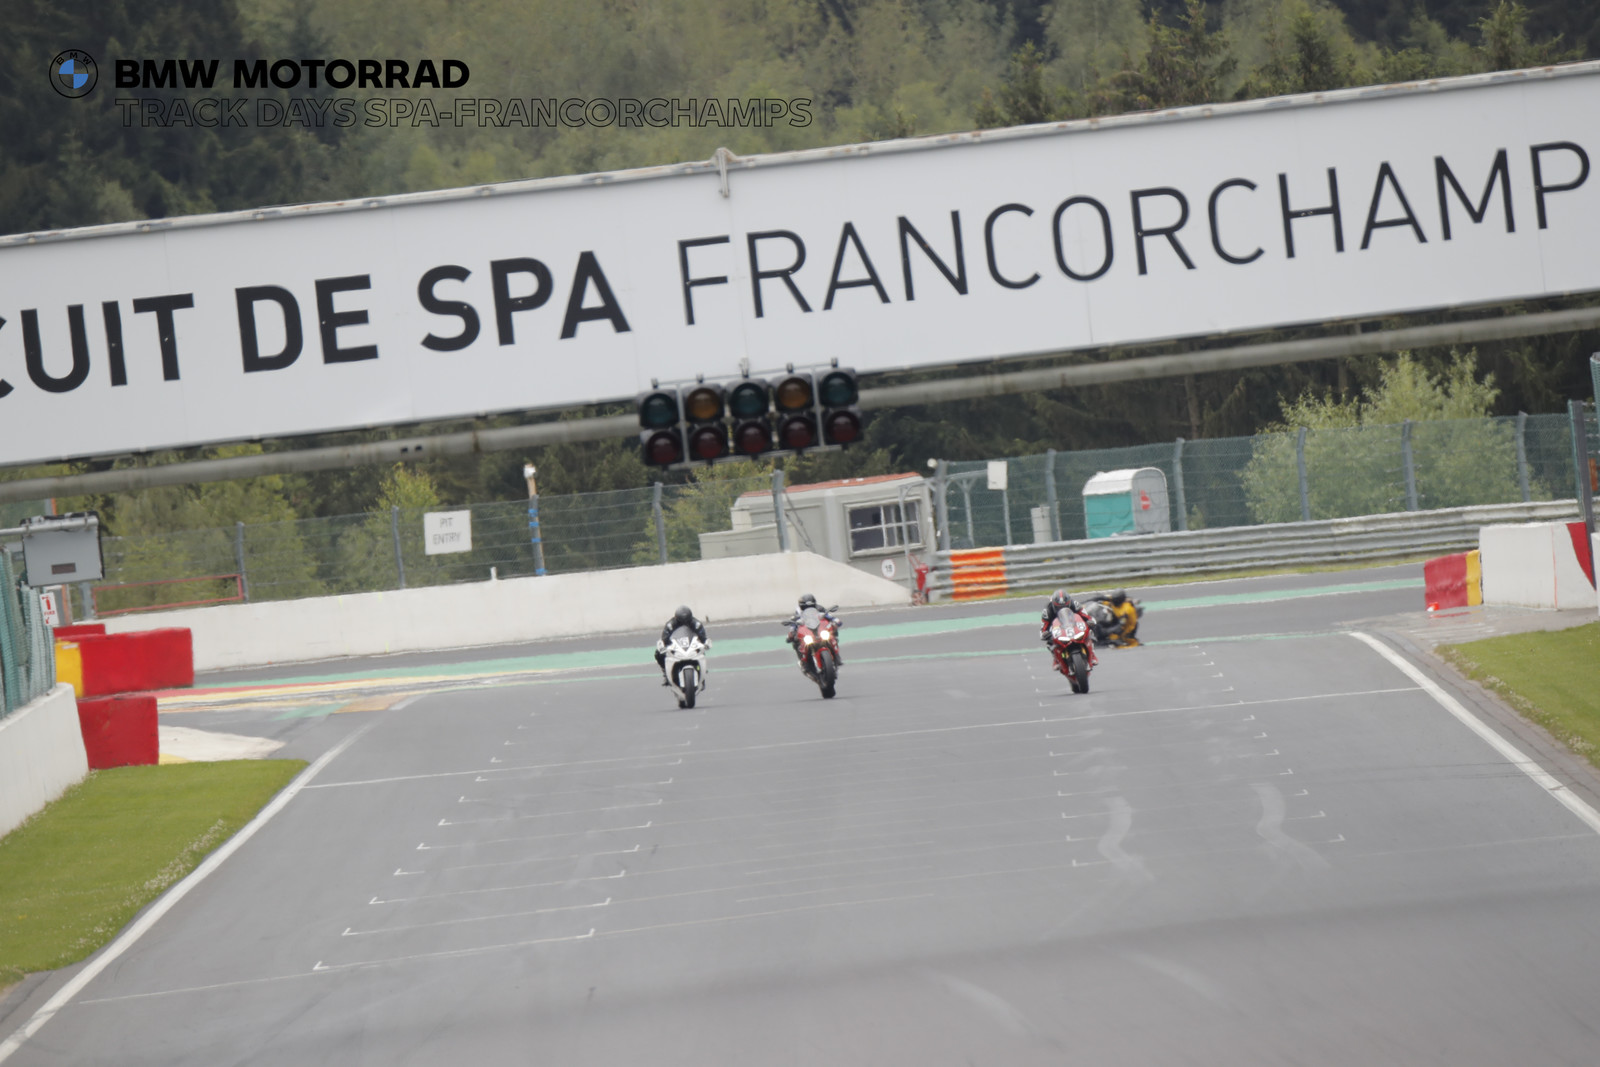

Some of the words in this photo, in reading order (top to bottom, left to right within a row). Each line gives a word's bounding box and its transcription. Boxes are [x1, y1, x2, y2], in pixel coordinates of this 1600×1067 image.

[0, 293, 194, 398] UIT
[235, 275, 378, 373] DE
[418, 251, 631, 351] SPA
[679, 141, 1590, 325] FRANCORCHAMP
[439, 517, 454, 529] PIT
[432, 532, 462, 545] ENTRY
